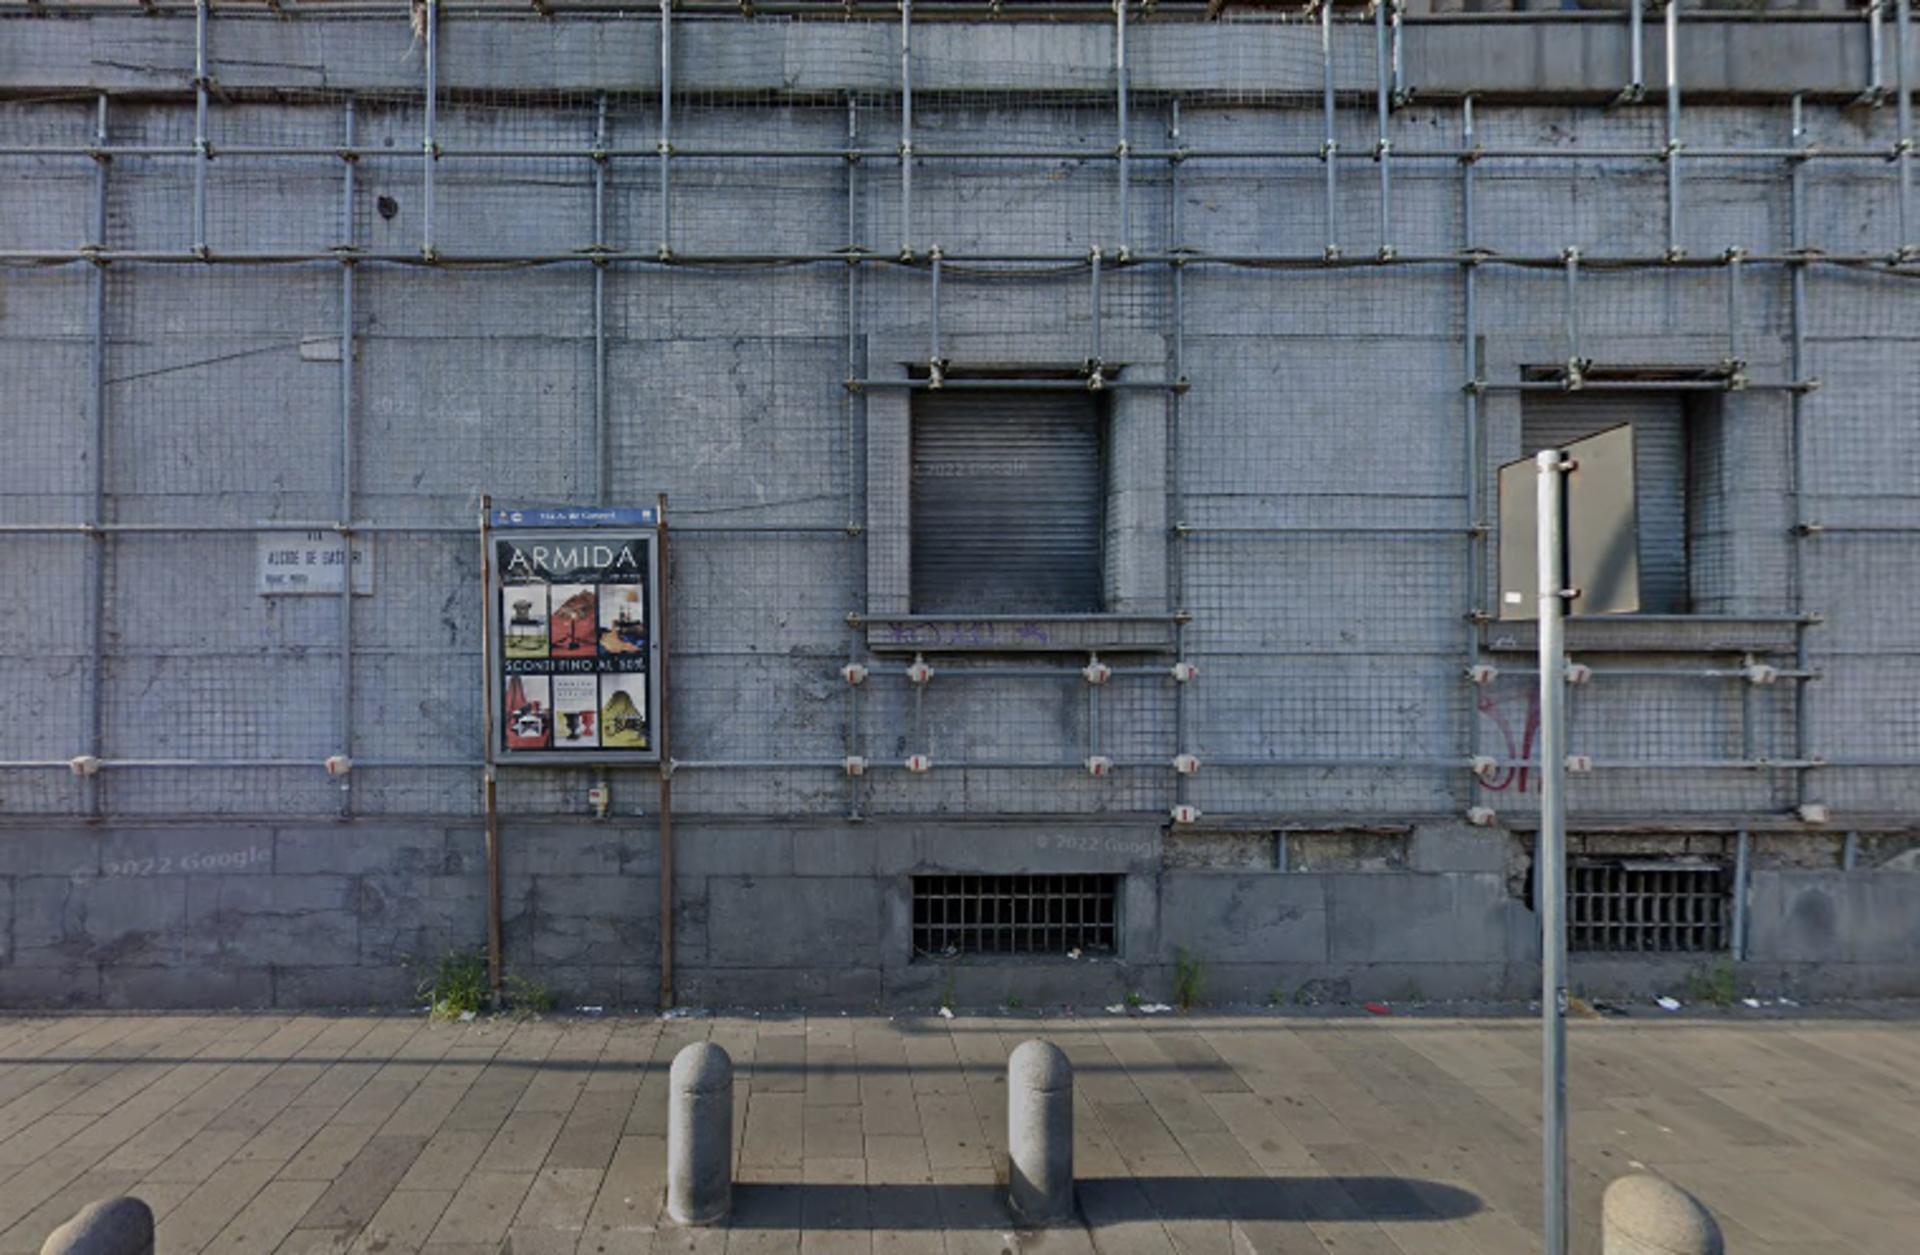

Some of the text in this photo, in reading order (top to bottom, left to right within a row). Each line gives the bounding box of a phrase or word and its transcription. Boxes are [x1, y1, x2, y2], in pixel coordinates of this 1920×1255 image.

[508, 545, 639, 571] ARMIDA
[505, 659, 555, 672] SCONTI
[560, 659, 593, 672] FINO
